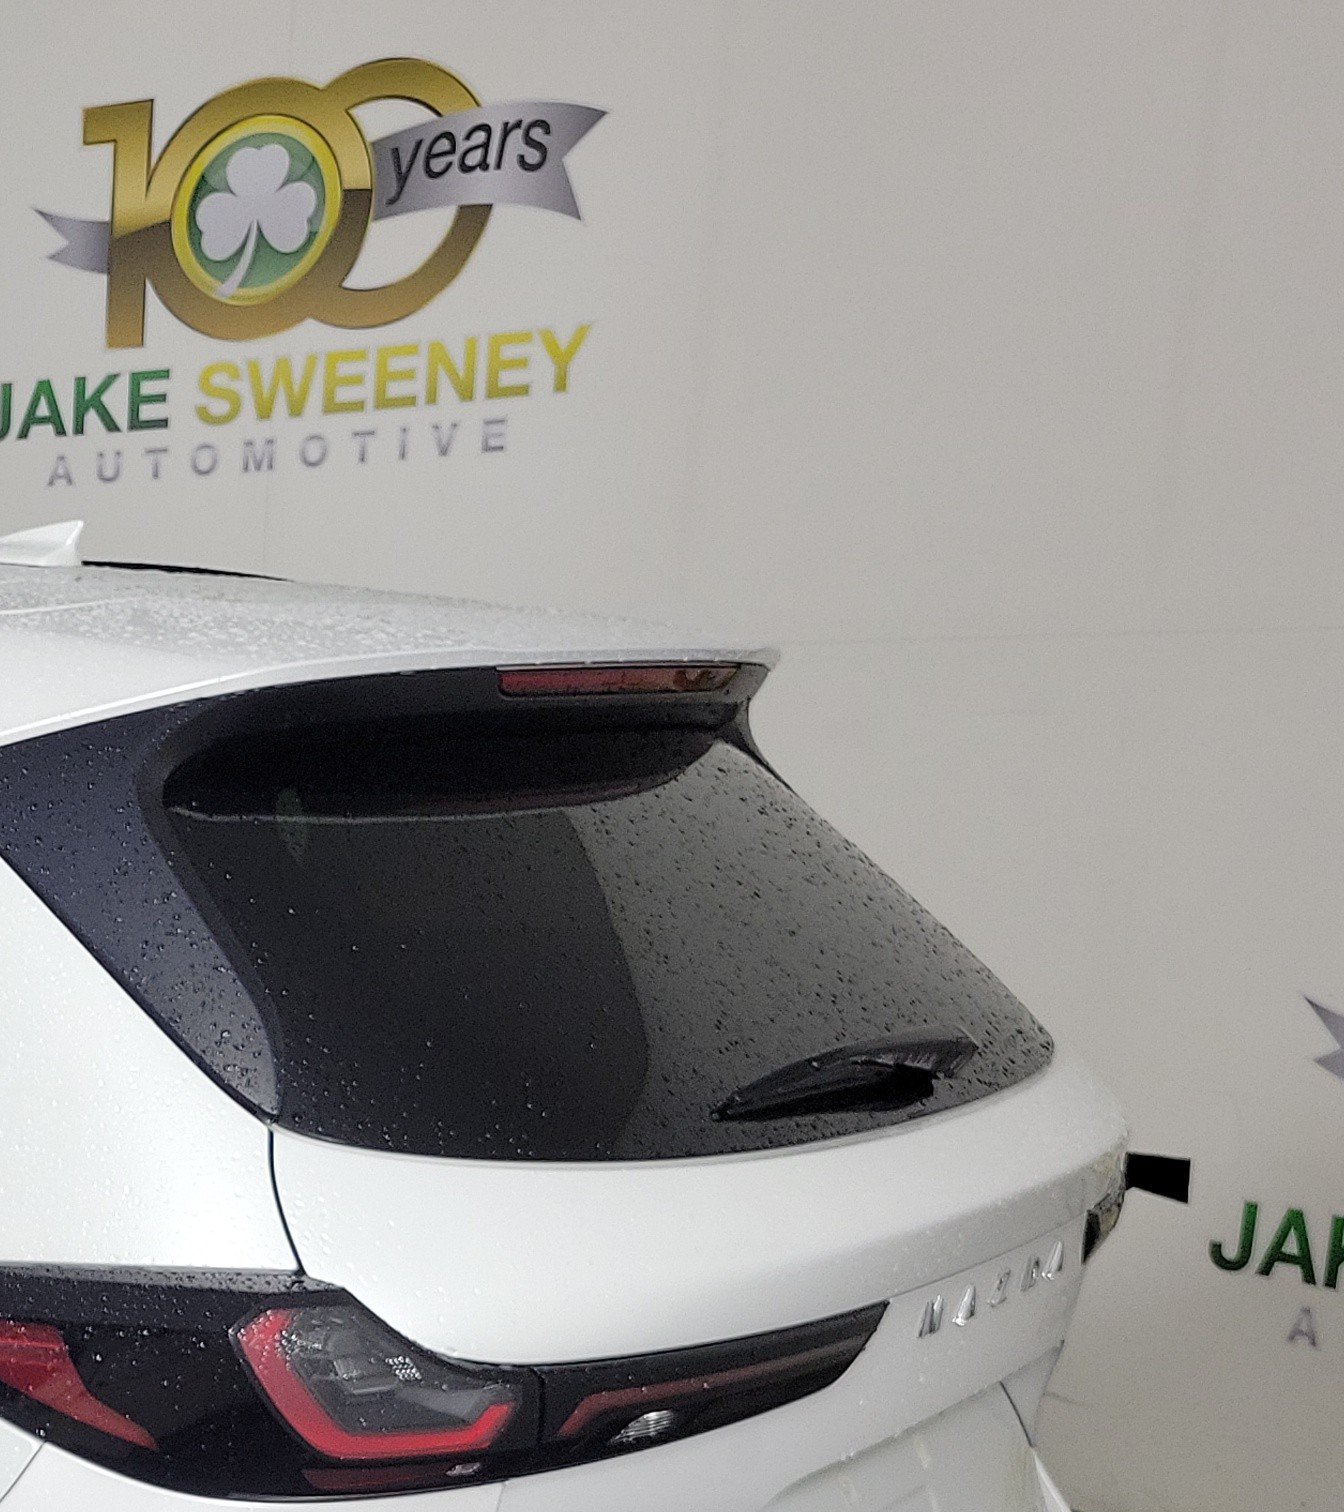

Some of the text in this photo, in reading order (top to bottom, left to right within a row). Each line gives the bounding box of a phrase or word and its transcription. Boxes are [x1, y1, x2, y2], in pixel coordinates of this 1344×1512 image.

[83, 57, 553, 348] 100 years
[196, 324, 592, 425] SWEENEY
[47, 418, 509, 487] AUTOMOTIVE
